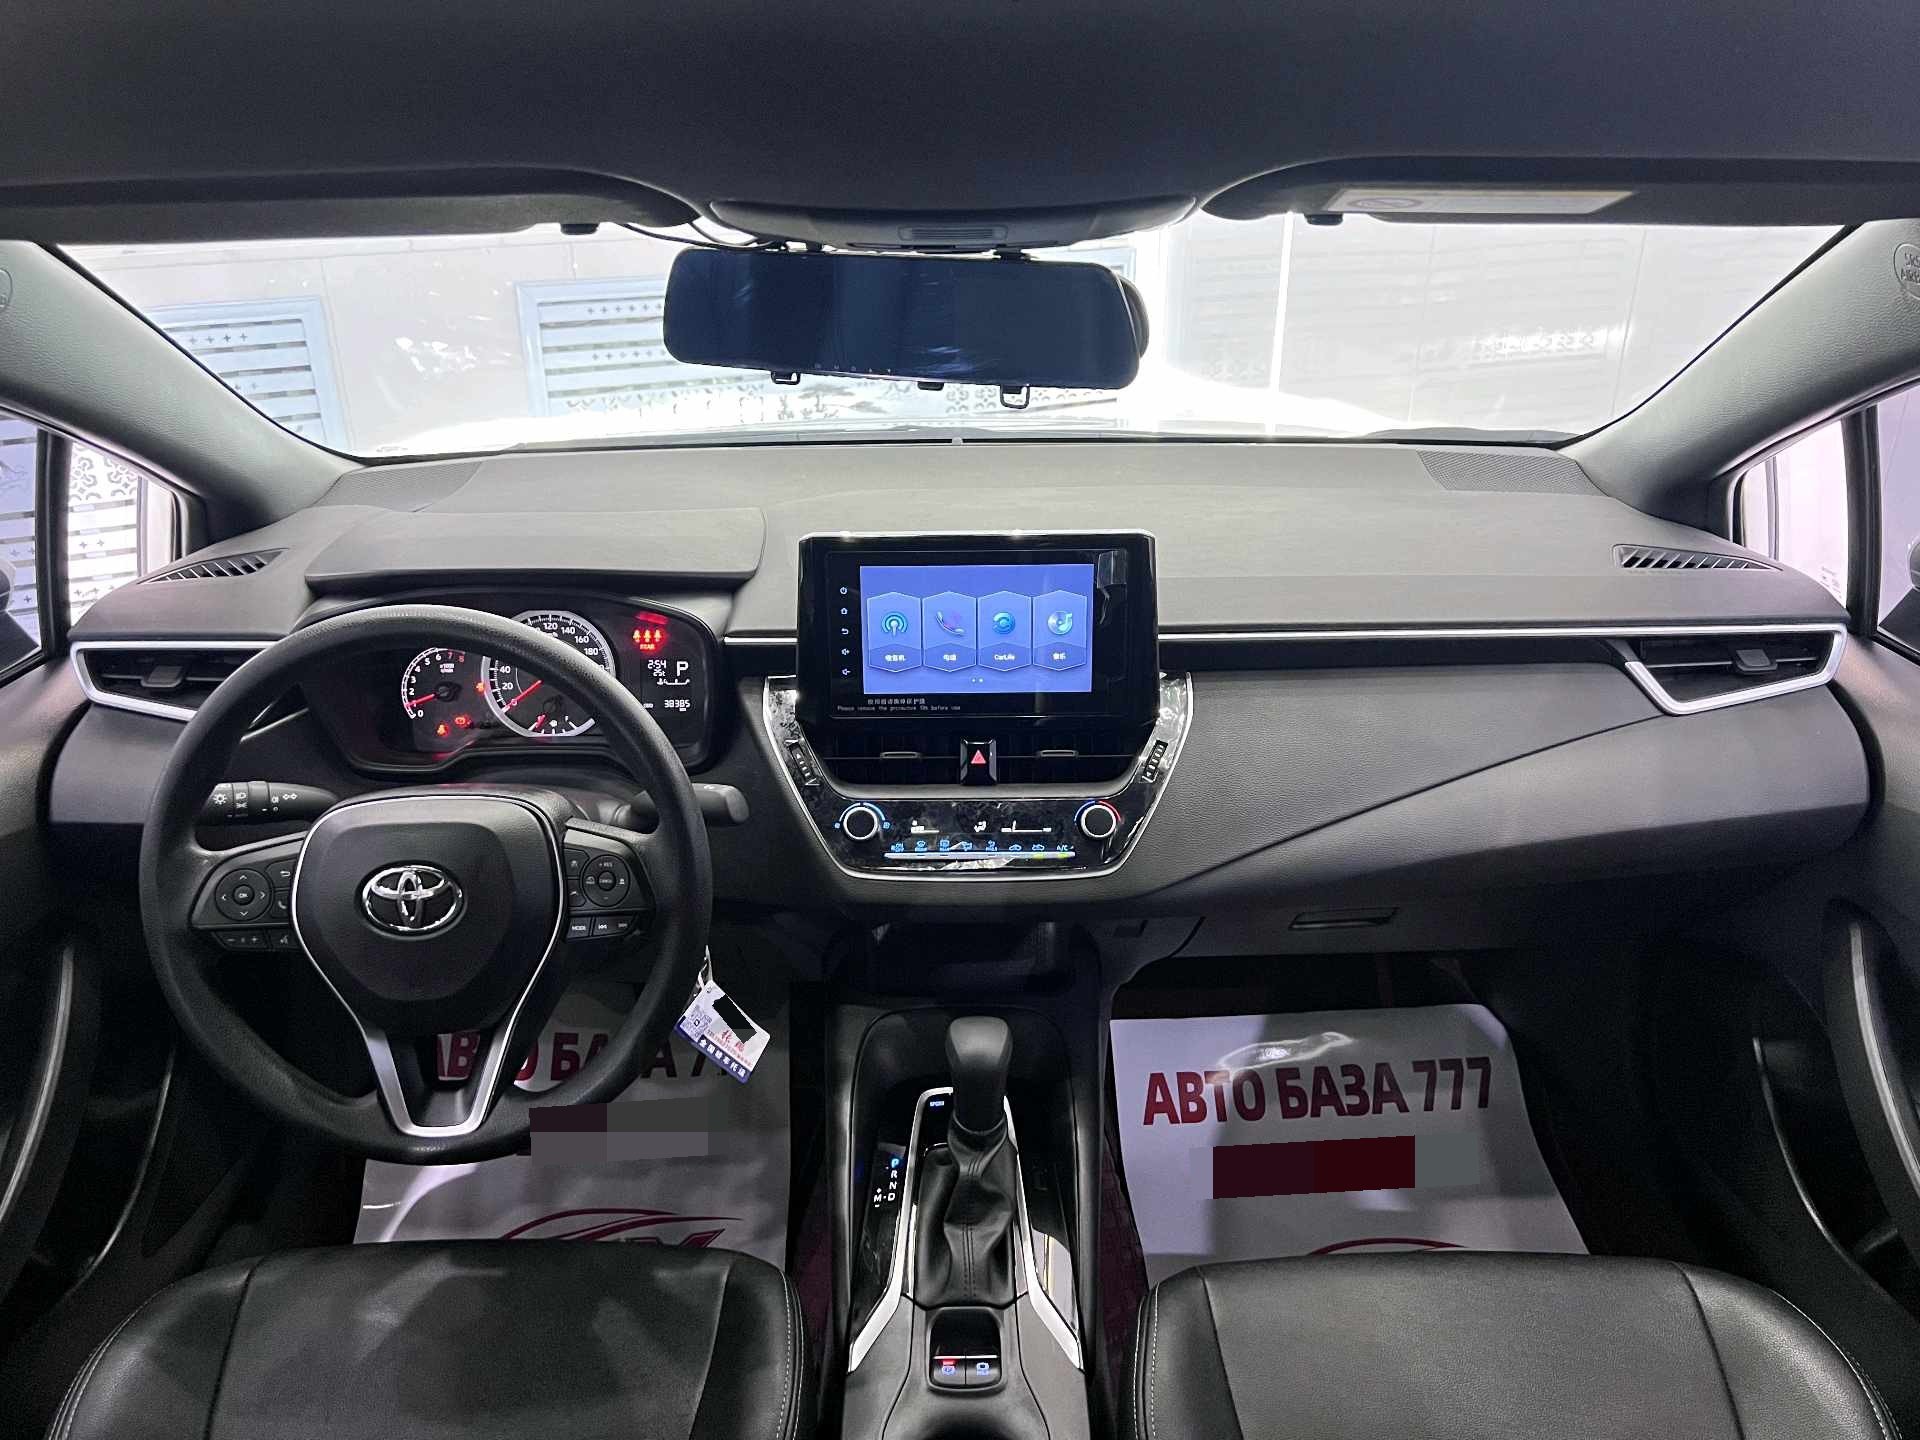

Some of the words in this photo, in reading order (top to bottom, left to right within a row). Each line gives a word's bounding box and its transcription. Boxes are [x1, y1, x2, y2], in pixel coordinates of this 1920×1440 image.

[543, 622, 558, 630] 120
[561, 626, 576, 635] 140
[574, 635, 590, 644] 160
[424, 658, 431, 666] 5
[500, 666, 511, 674] 40
[676, 661, 689, 677] P
[410, 676, 417, 684] 3
[502, 682, 514, 690] 20
[409, 688, 415, 696] 2
[417, 710, 424, 718] 0
[1143, 1067, 1267, 1126] АВТО
[1275, 1062, 1410, 1120] БАЗА
[1411, 1057, 1492, 1112] 777
[891, 1158, 900, 1168] P
[890, 1170, 898, 1179] R
[889, 1181, 898, 1190] N
[873, 1193, 882, 1203] M
[887, 1192, 896, 1201] D
